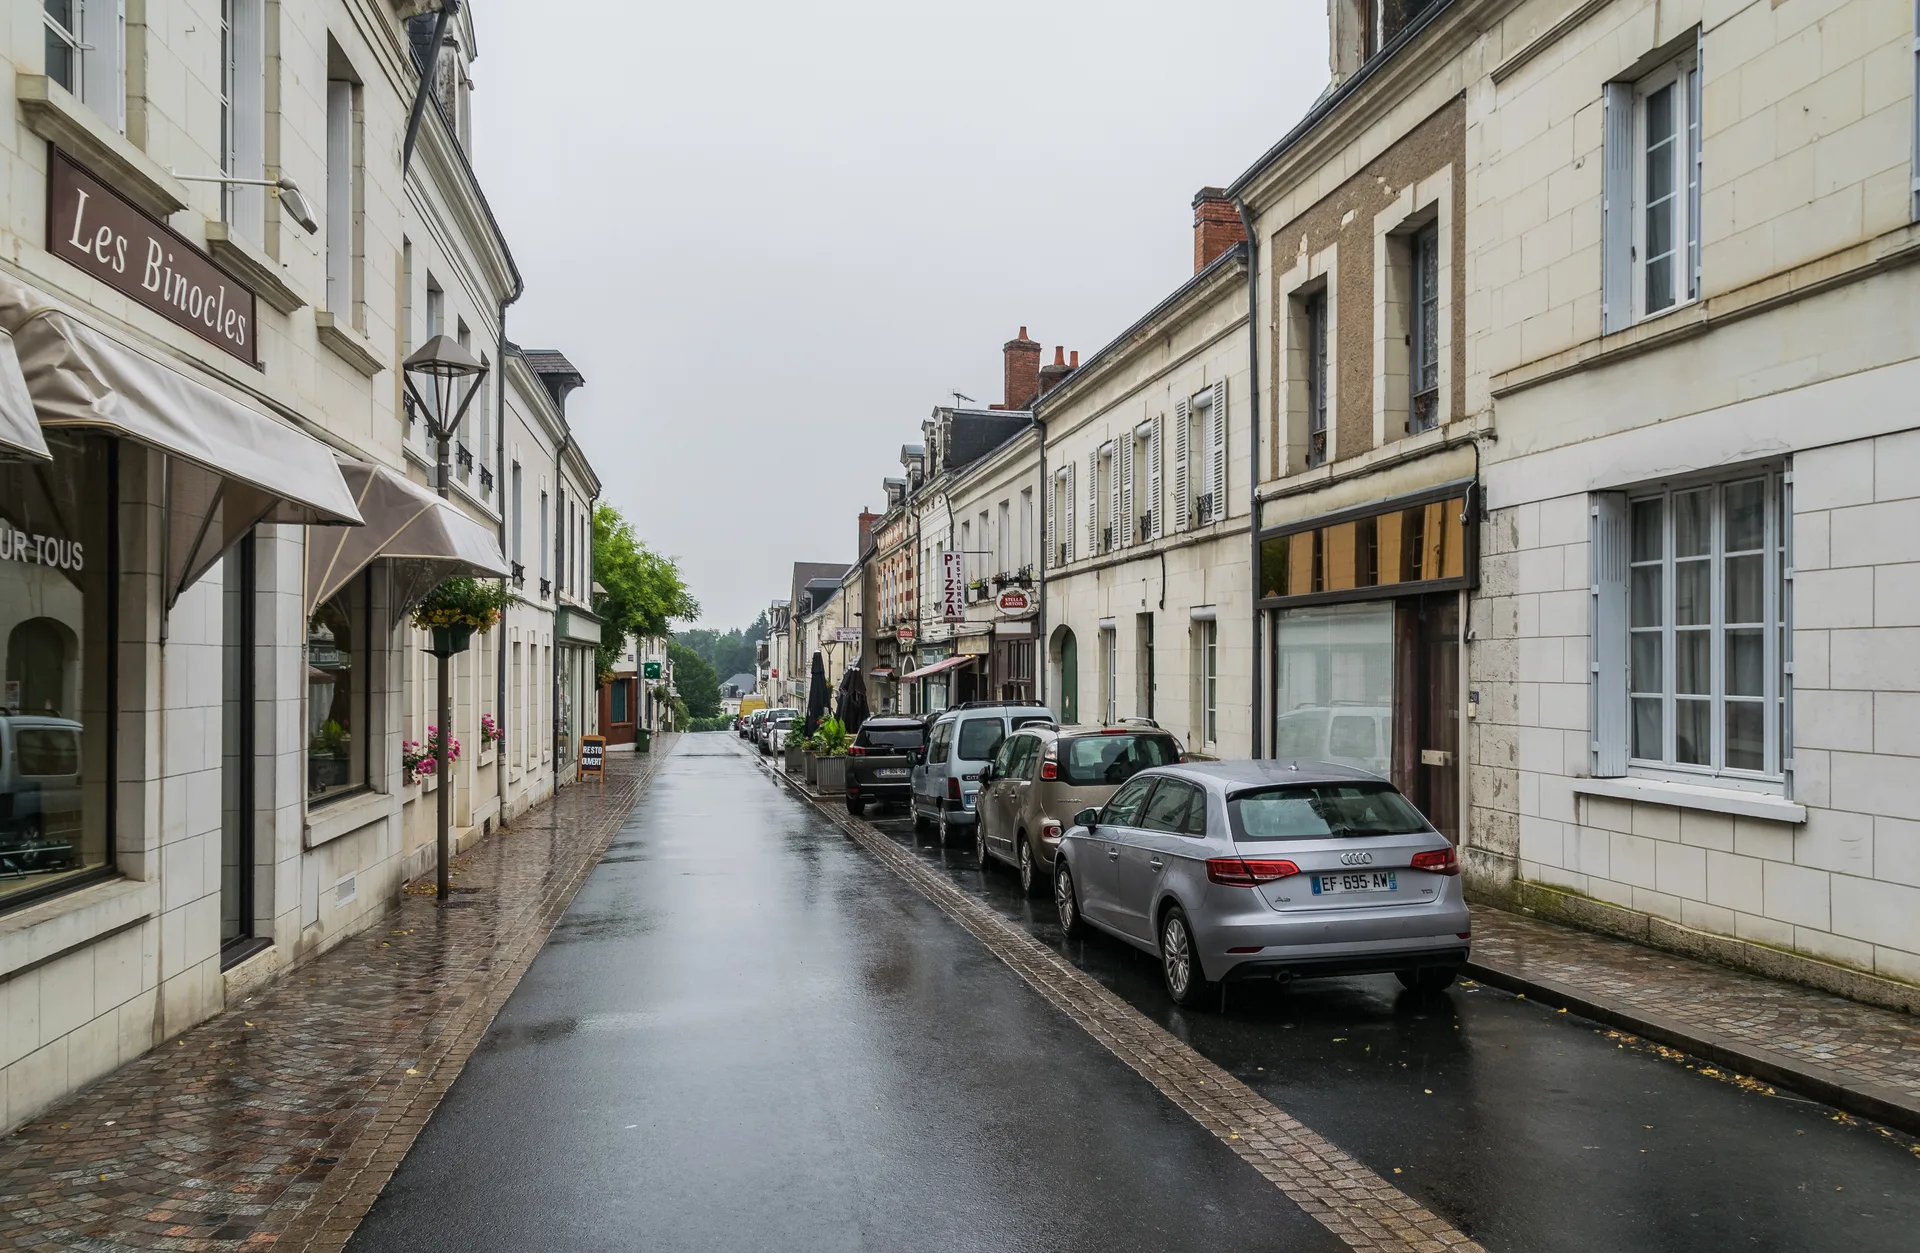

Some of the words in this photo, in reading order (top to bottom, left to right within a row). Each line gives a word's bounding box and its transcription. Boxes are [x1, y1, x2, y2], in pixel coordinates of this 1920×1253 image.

[68, 187, 128, 274] Les
[141, 236, 246, 346] Binocles
[0, 528, 28, 563] UR
[33, 534, 84, 571] TOUS
[944, 554, 956, 616] PIZZA
[583, 745, 602, 754] RESTO
